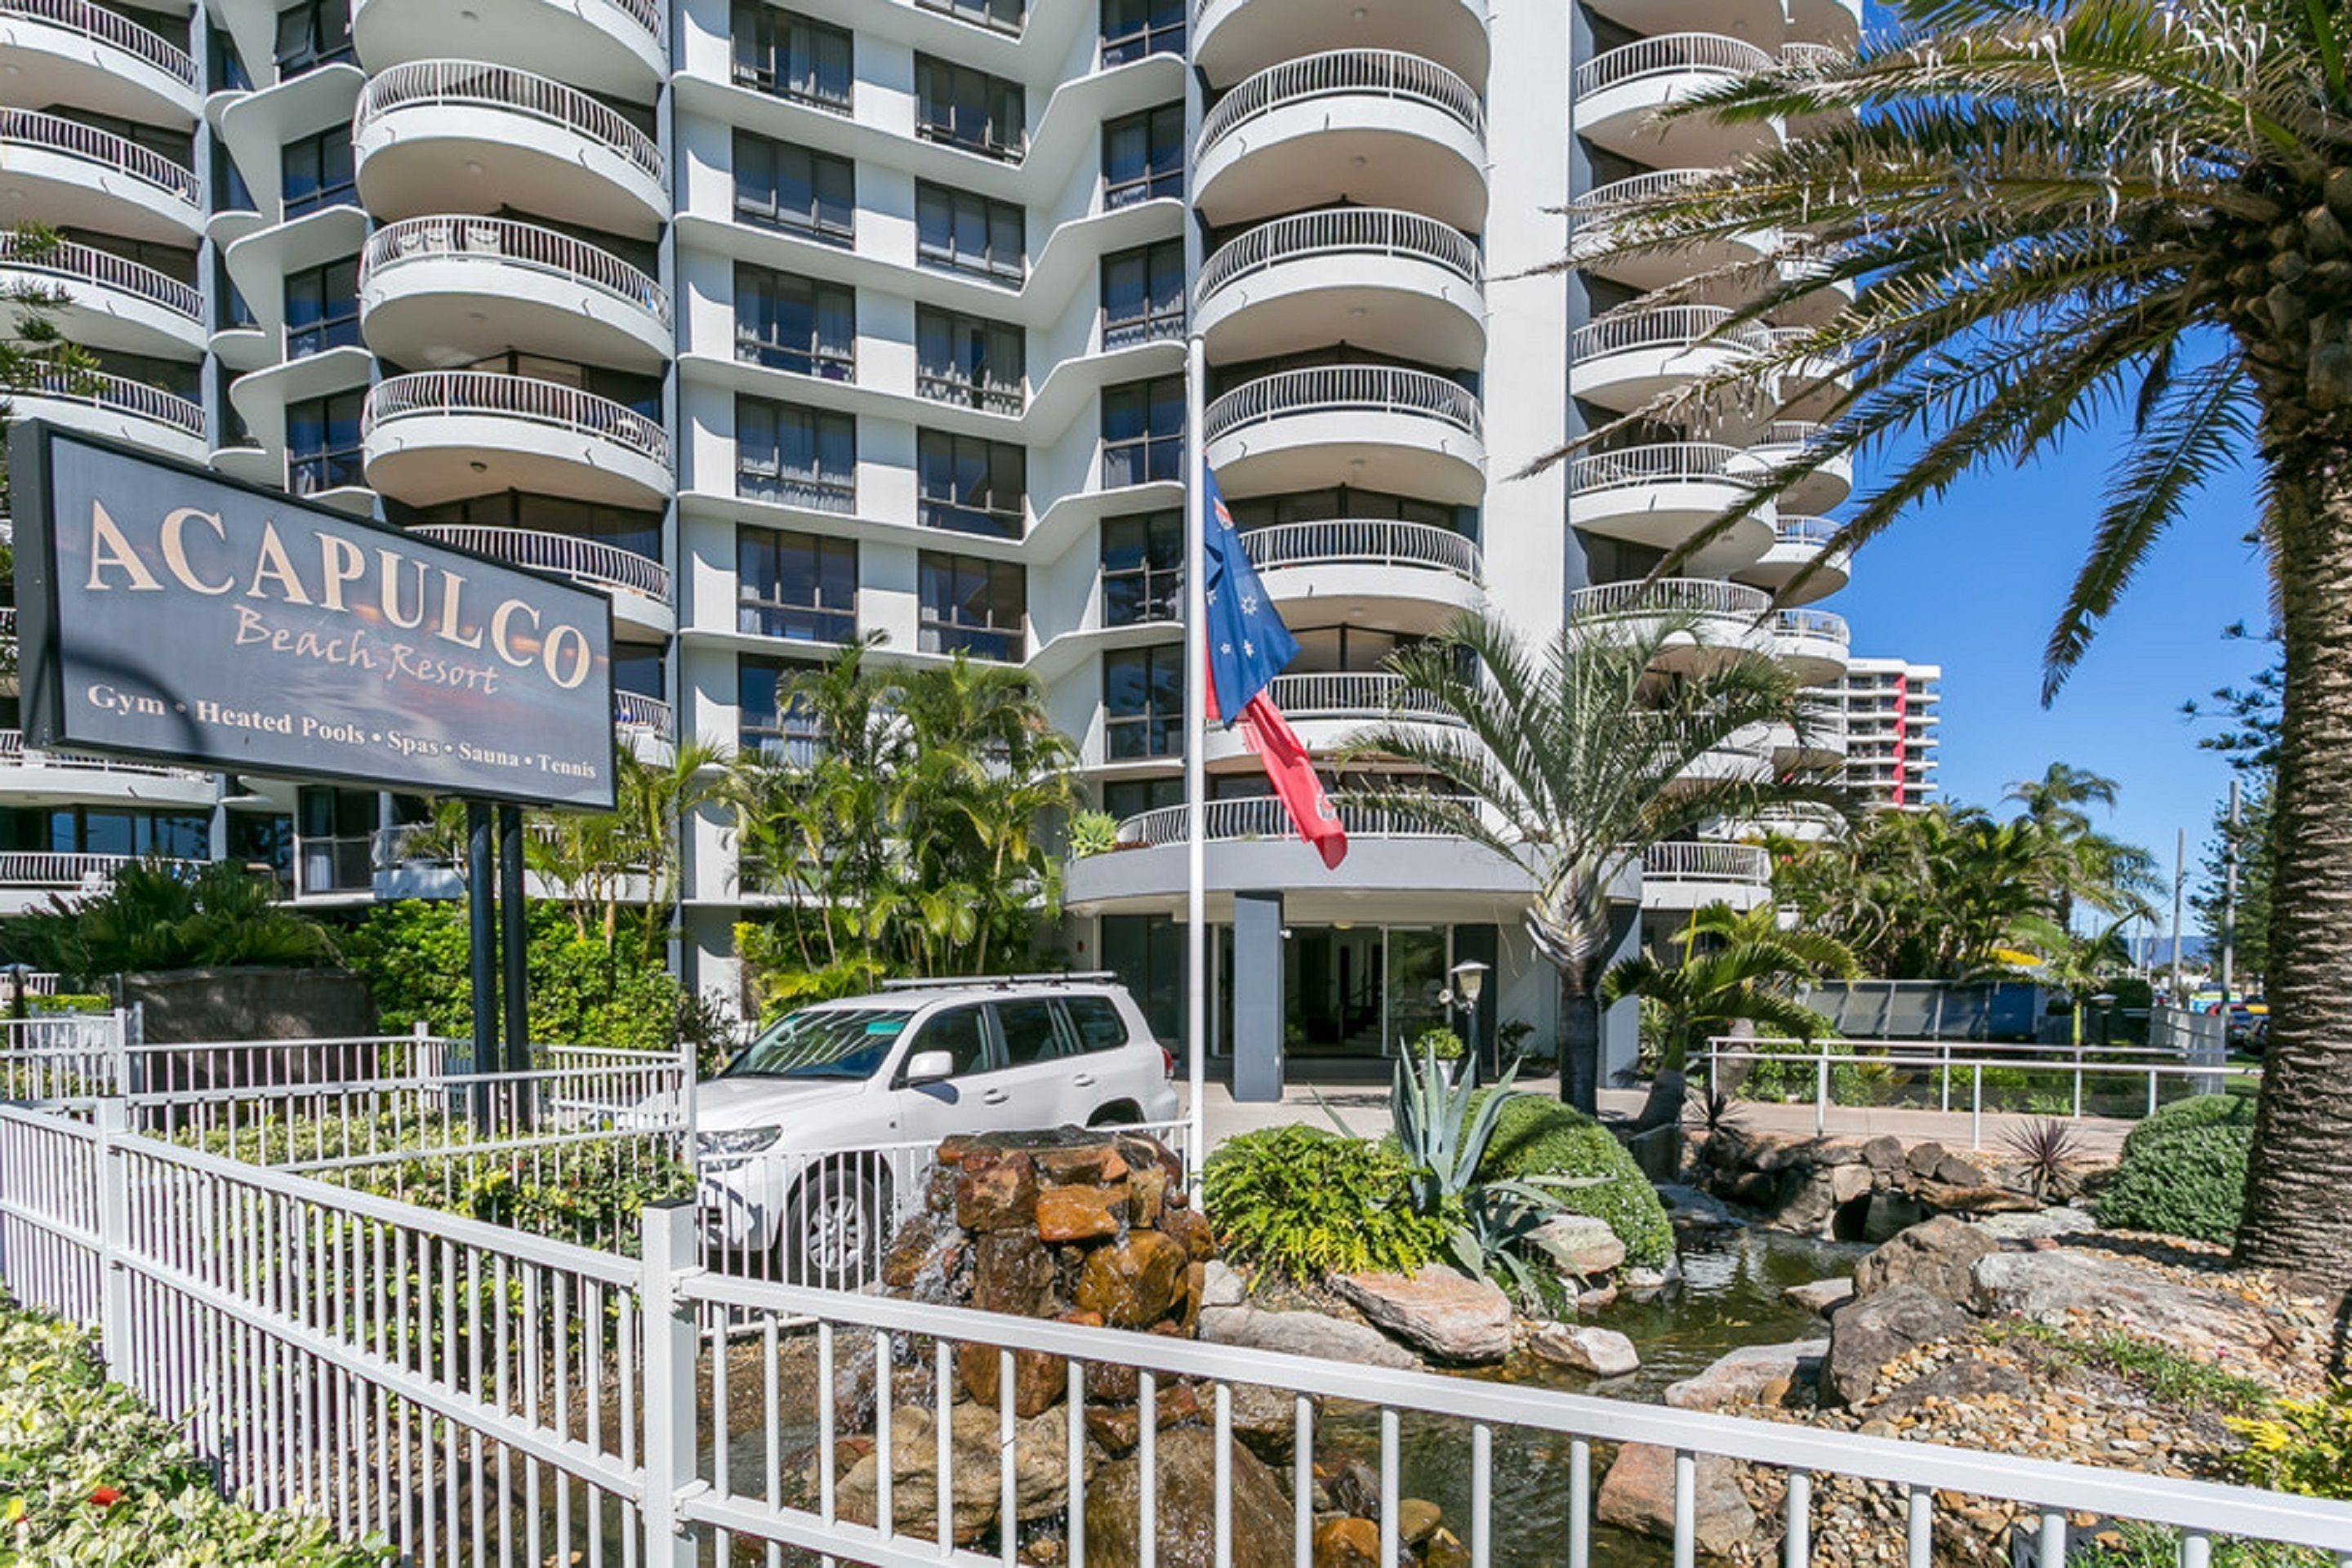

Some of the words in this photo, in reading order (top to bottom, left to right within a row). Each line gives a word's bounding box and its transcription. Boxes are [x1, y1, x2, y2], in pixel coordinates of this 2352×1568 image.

[84, 499, 590, 689] ACAPULCO
[233, 604, 377, 669] Beach
[386, 643, 500, 694] Resort
[87, 683, 165, 715] Gym
[196, 699, 292, 734] Heated
[302, 716, 365, 745] Pools
[387, 729, 439, 755] Spas
[458, 742, 519, 768] Sauna
[537, 753, 597, 779] Tennis
